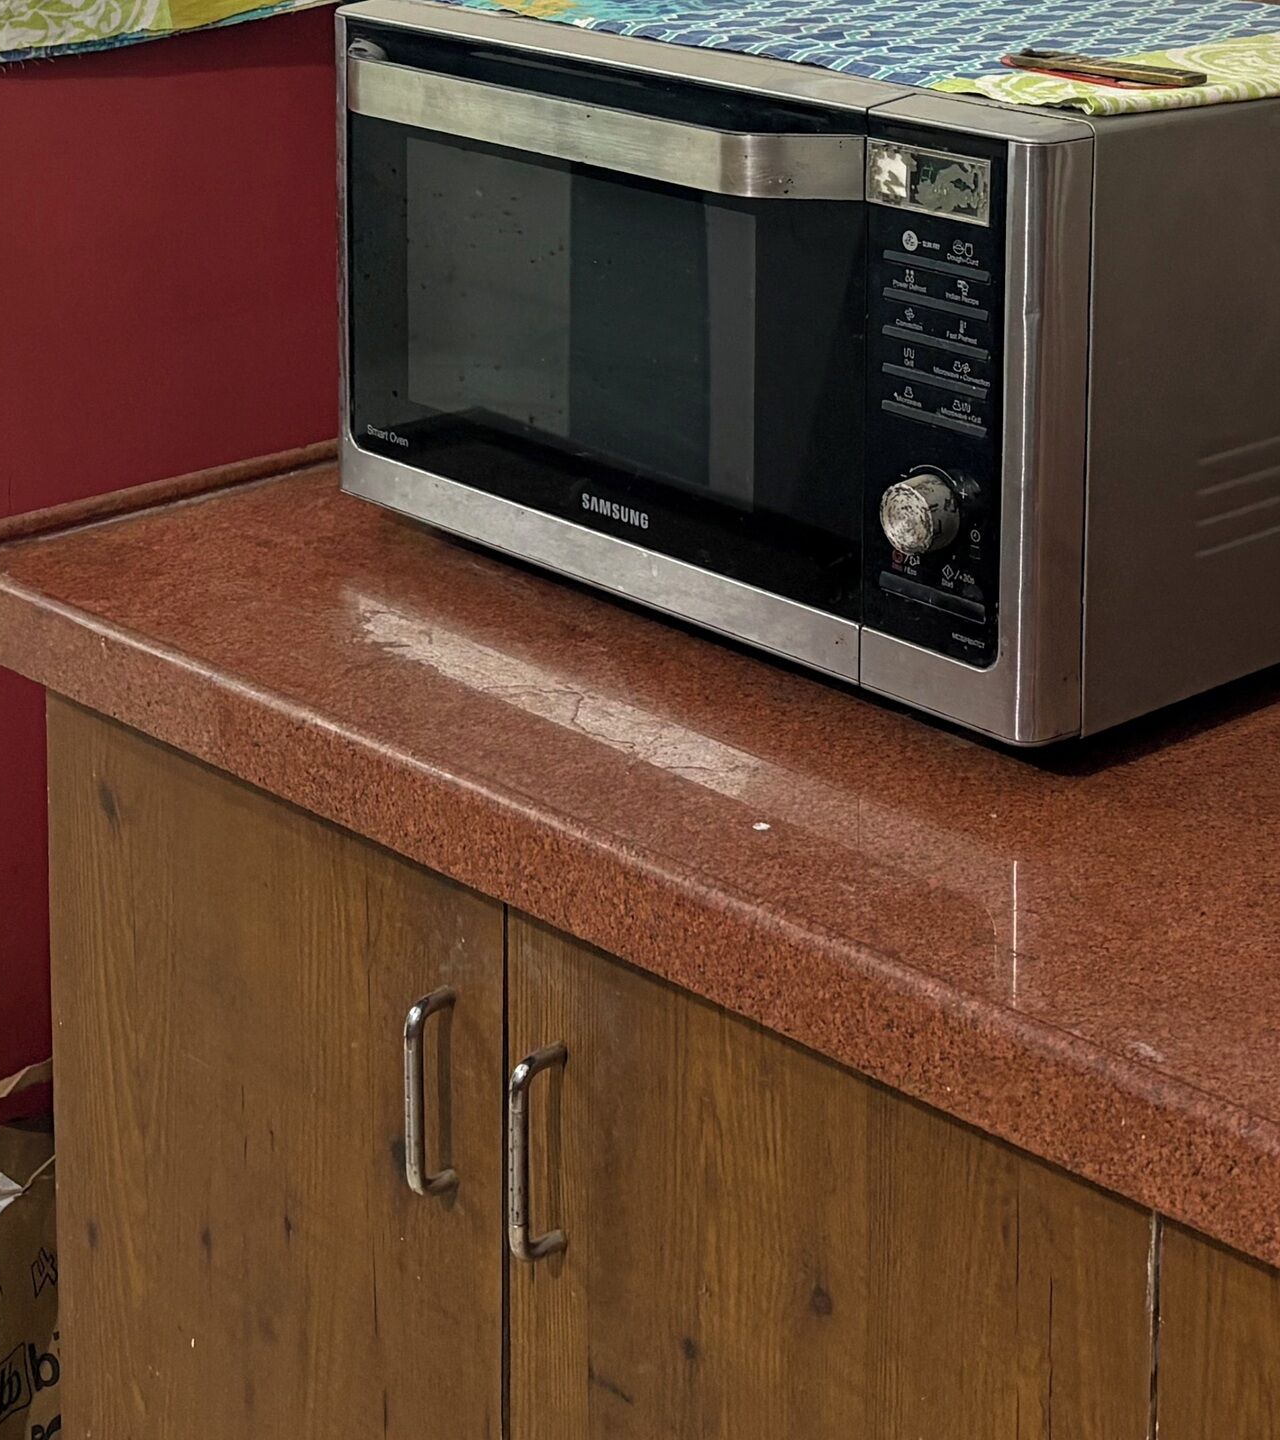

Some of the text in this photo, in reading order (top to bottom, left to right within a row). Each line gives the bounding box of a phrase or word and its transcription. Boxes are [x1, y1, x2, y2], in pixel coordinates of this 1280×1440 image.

[367, 424, 409, 448] Smart Oven
[581, 492, 650, 530] SAMSUNG
